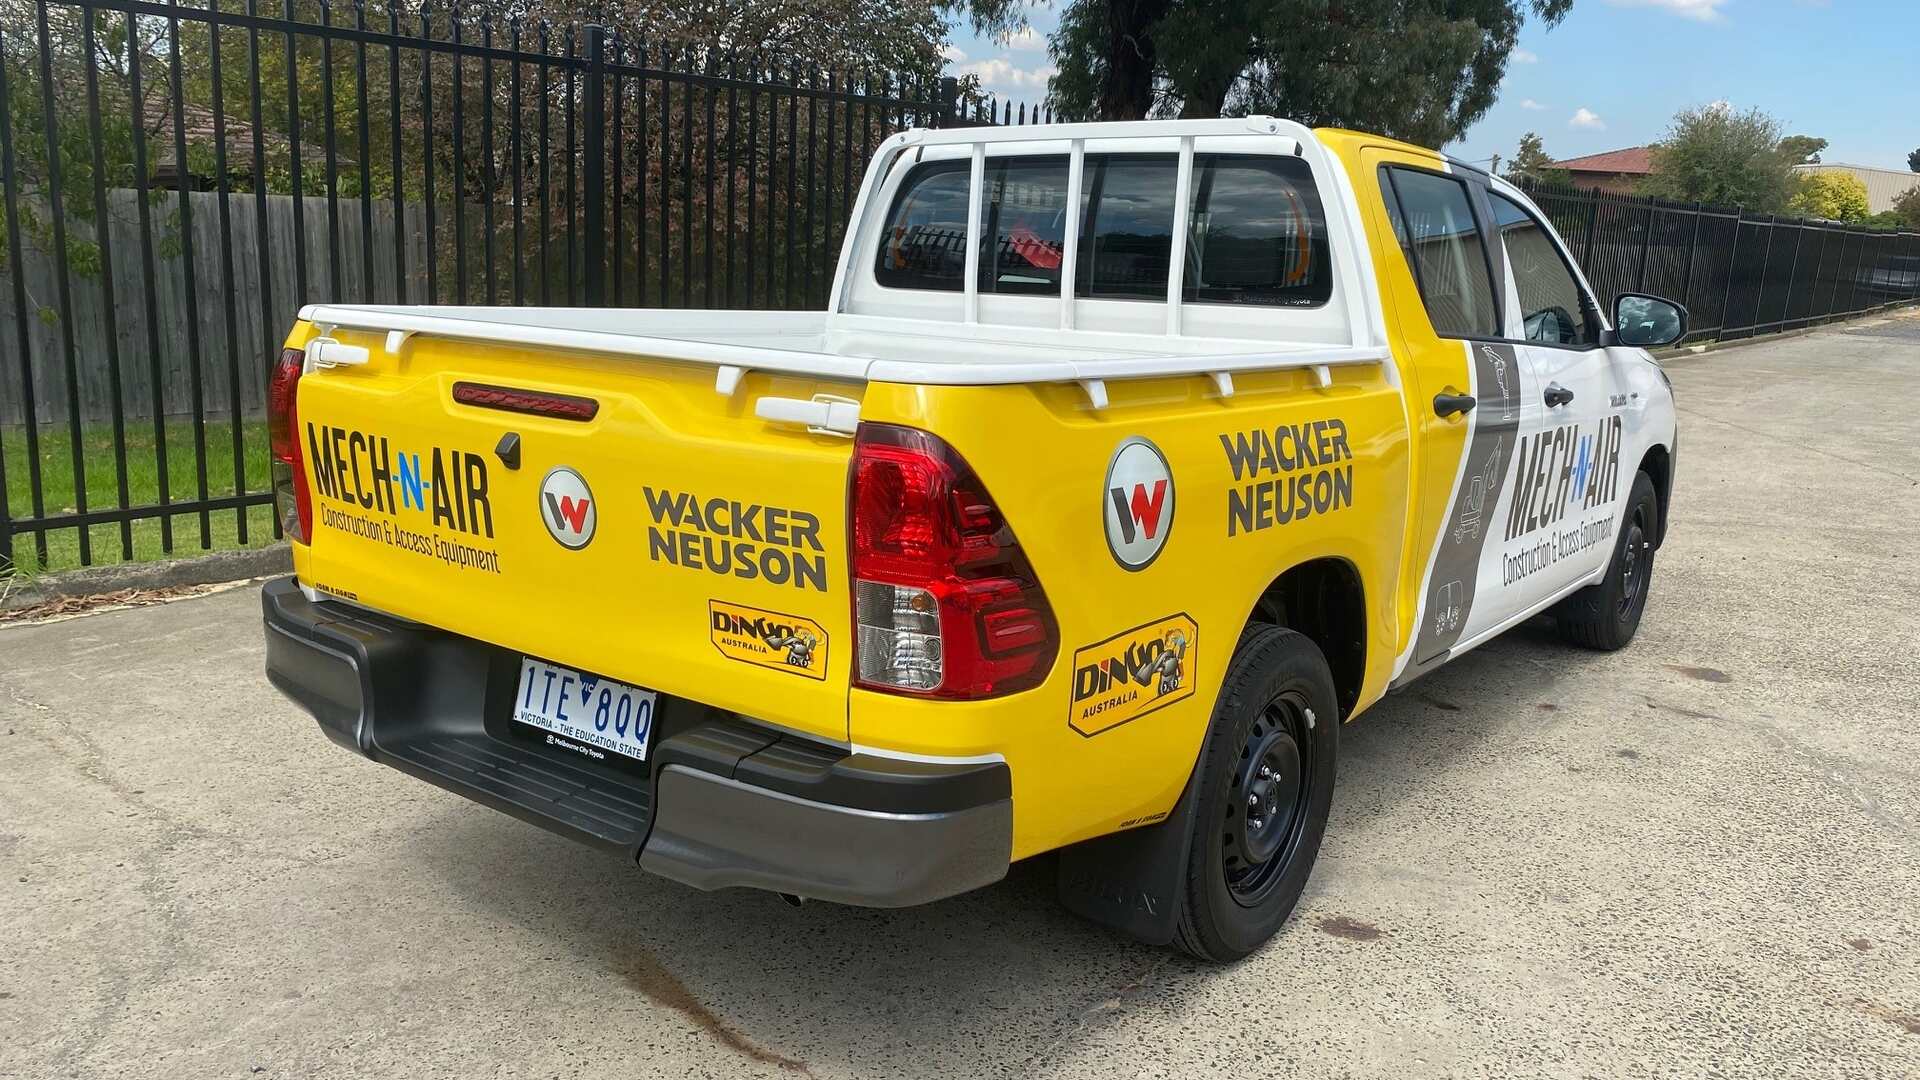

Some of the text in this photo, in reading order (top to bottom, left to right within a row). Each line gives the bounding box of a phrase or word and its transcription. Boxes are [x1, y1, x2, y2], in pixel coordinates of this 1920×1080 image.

[307, 422, 494, 538] MECH-N-AIR
[1219, 418, 1352, 481] WACKER
[1504, 415, 1622, 542] MECH-N-AIR
[642, 486, 825, 552] WACKER
[1228, 465, 1353, 538] NEUSON
[321, 502, 500, 573] Construction & Access Equipment
[648, 527, 828, 592] NEUSON
[1503, 512, 1614, 587] Construction & Access Equipment
[721, 637, 767, 654] AUSTRALIA
[525, 666, 650, 745] 1TE 8QQ
[582, 682, 594, 693] VIC
[1082, 690, 1138, 720] AUSTRALIA
[521, 711, 552, 729] VICTORIA
[560, 723, 574, 736] THE
[575, 728, 617, 751] EDUCATION
[618, 743, 642, 758] STATE
[554, 737, 604, 760] Melbourne City Toyota
